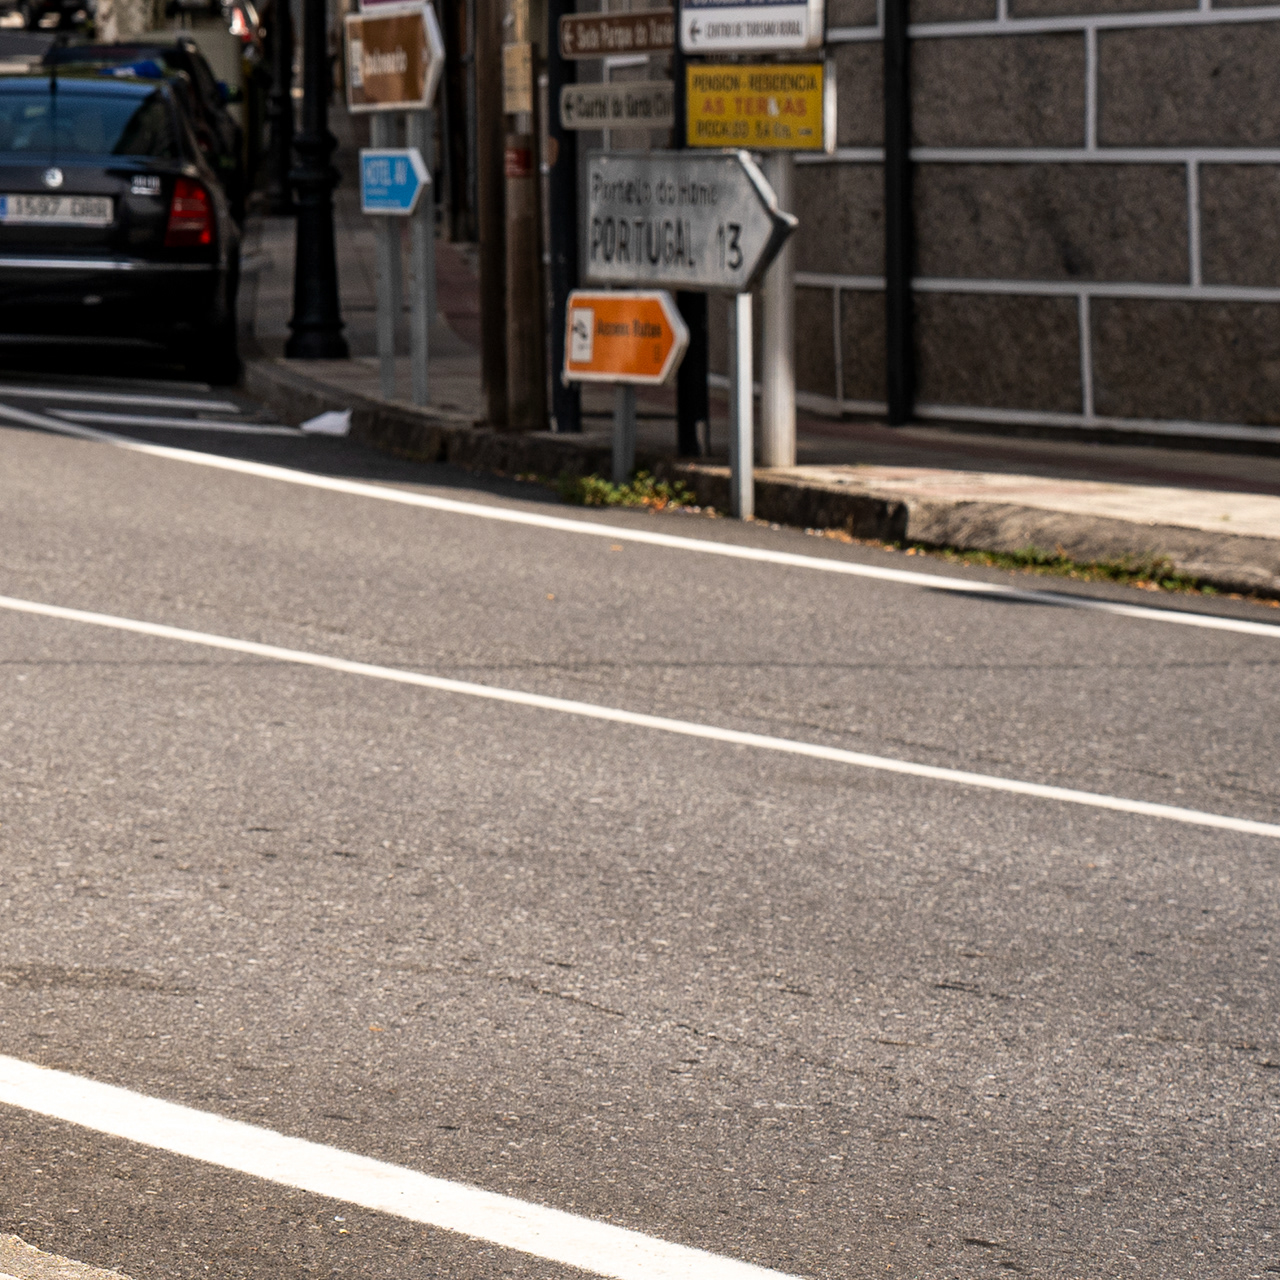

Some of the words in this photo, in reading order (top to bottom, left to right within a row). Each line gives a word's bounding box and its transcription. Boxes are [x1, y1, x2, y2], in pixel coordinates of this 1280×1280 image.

[702, 96, 725, 115] AS
[591, 217, 696, 267] PORTUGAL
[716, 222, 743, 270] 13
